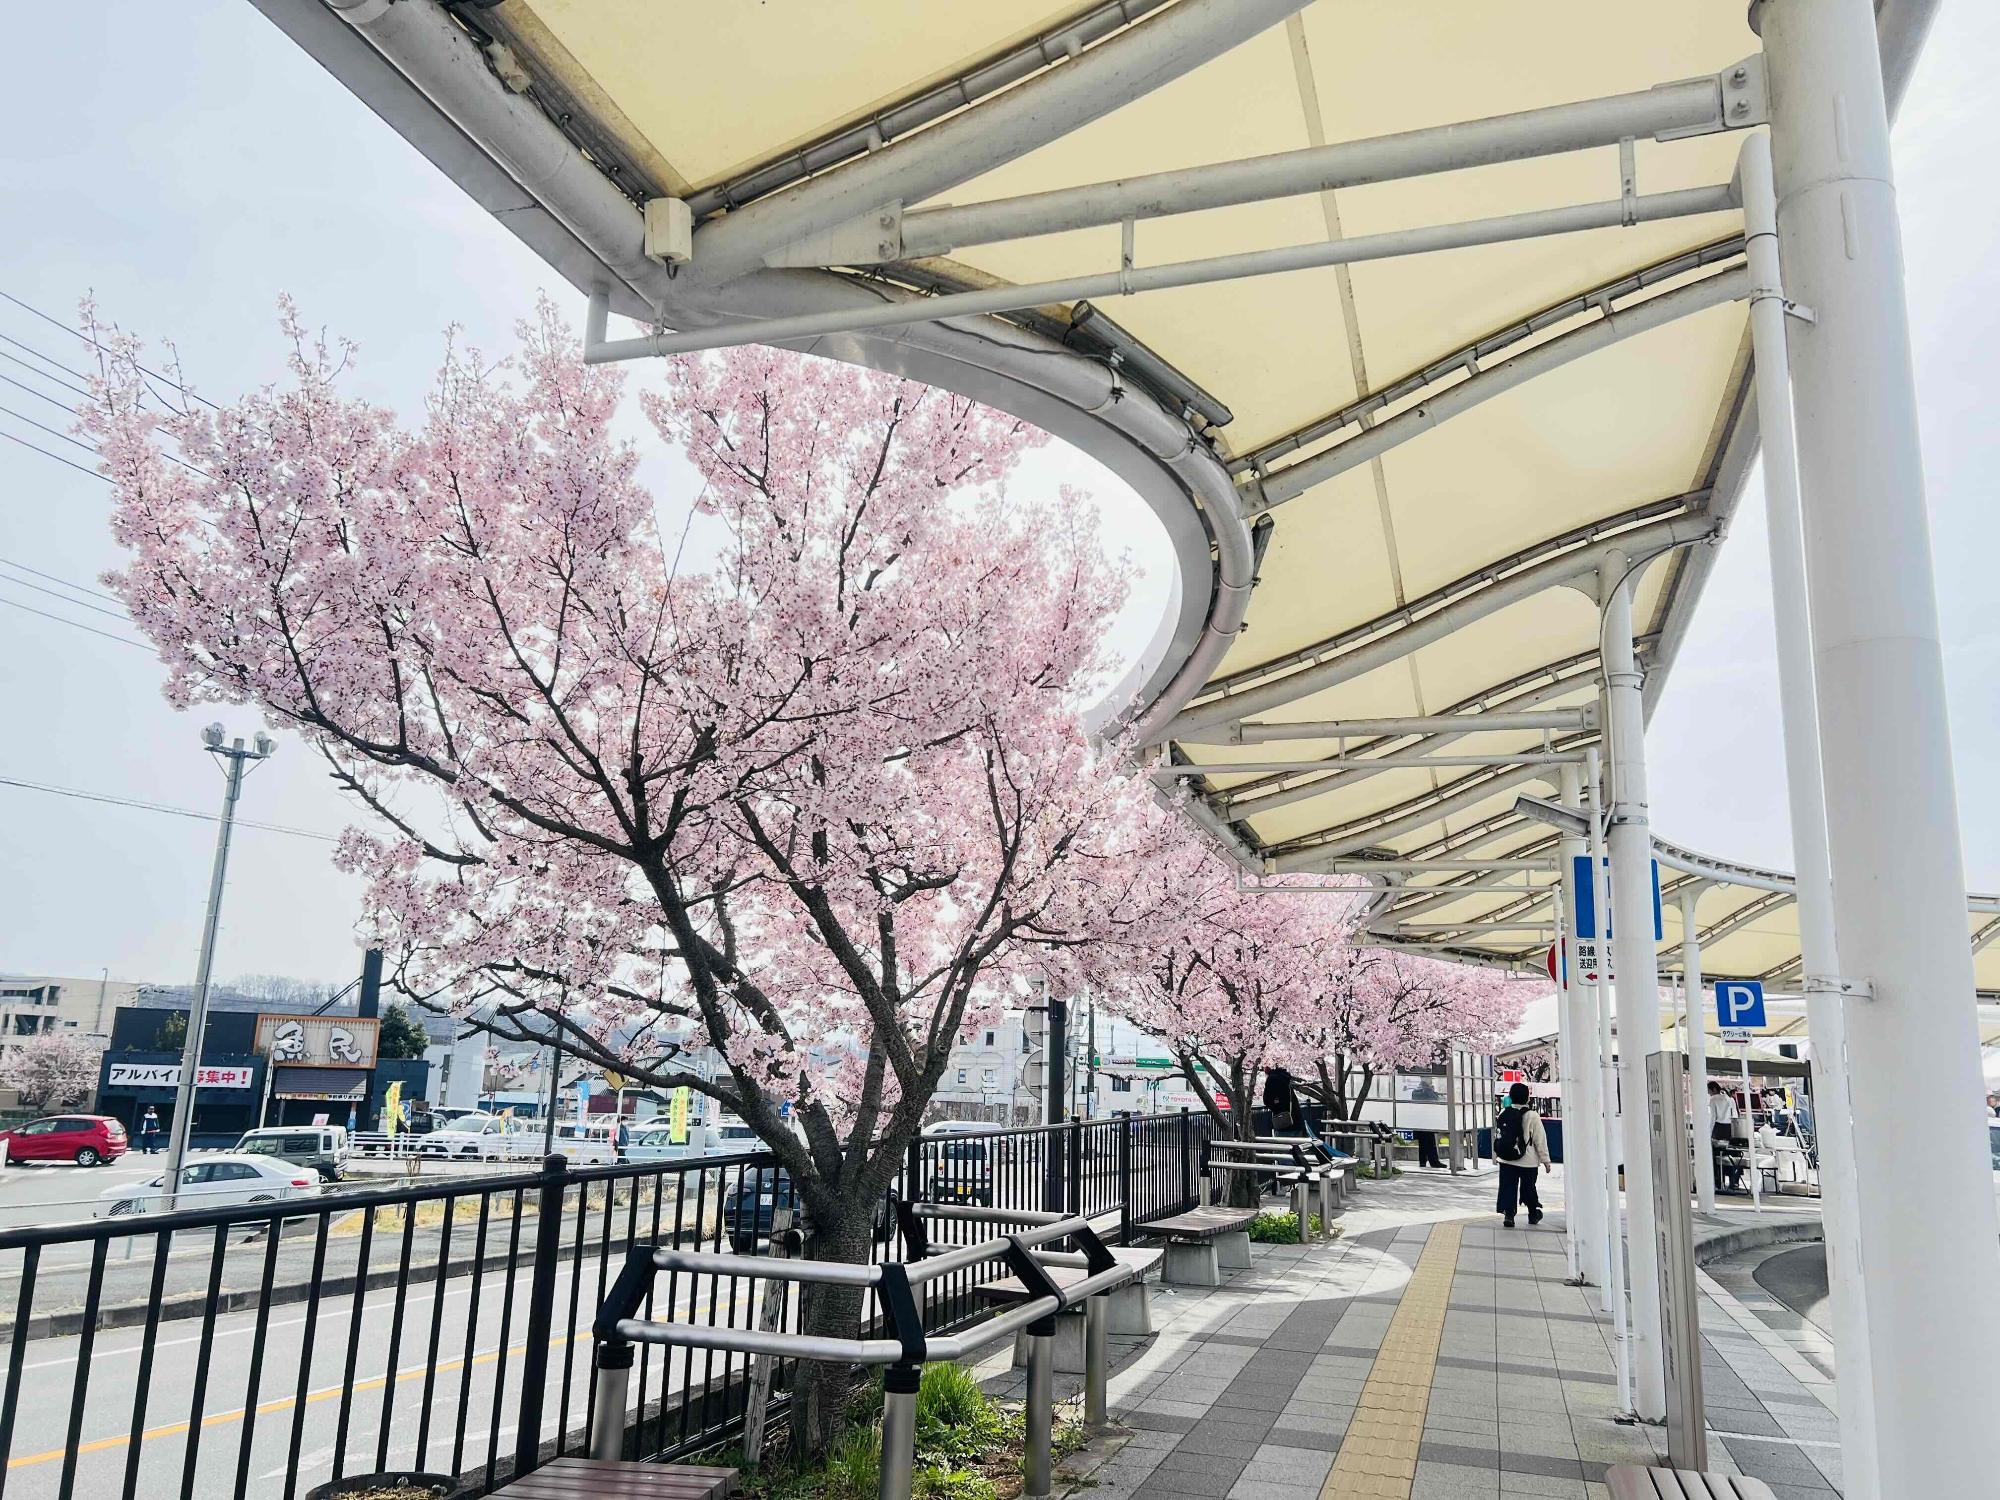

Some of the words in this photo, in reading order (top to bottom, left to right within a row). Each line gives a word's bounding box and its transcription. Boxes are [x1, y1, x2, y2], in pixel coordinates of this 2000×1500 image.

[1728, 986, 1755, 1022] P
[274, 1020, 362, 1063] 魚民
[111, 1068, 248, 1085] アルバイ集中！
